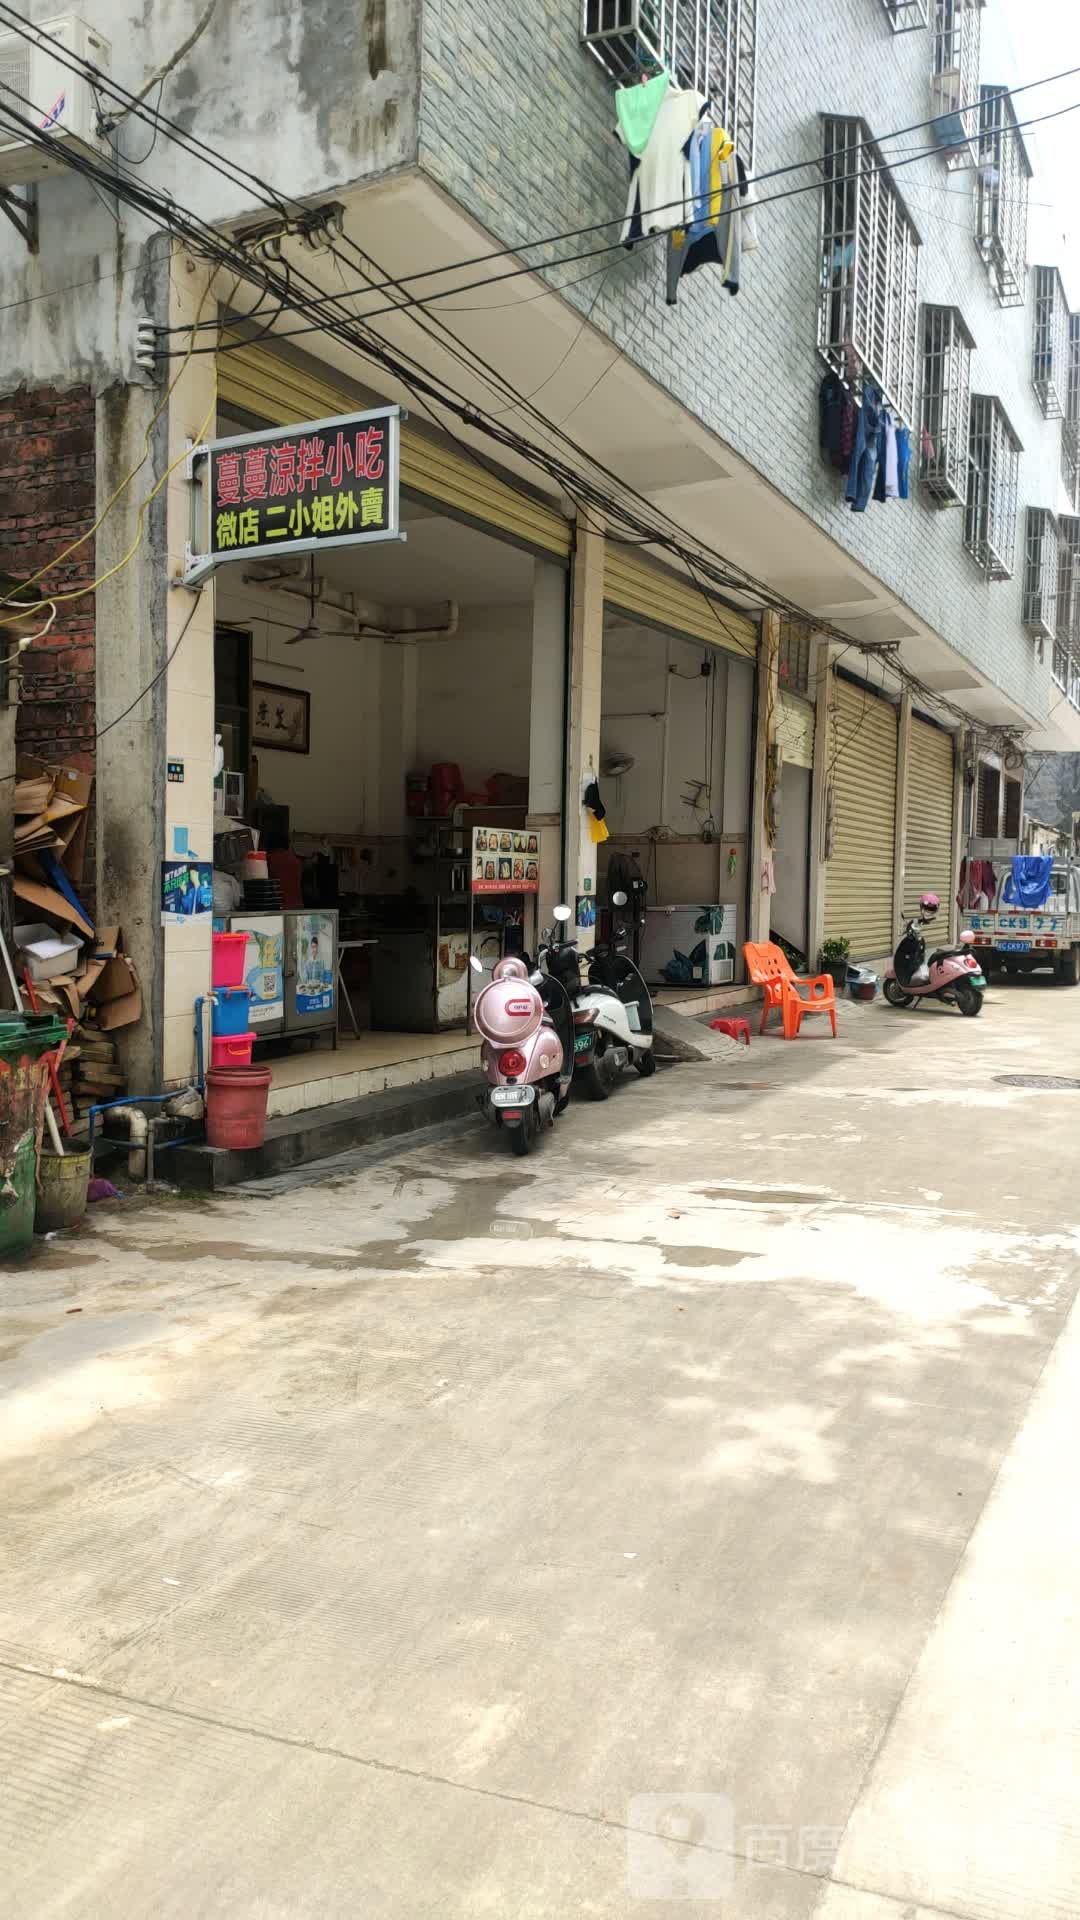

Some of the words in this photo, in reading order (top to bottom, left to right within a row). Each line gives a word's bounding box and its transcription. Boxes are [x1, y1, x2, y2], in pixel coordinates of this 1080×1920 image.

[217, 426, 385, 506] 蔓蔓涼拌小吃
